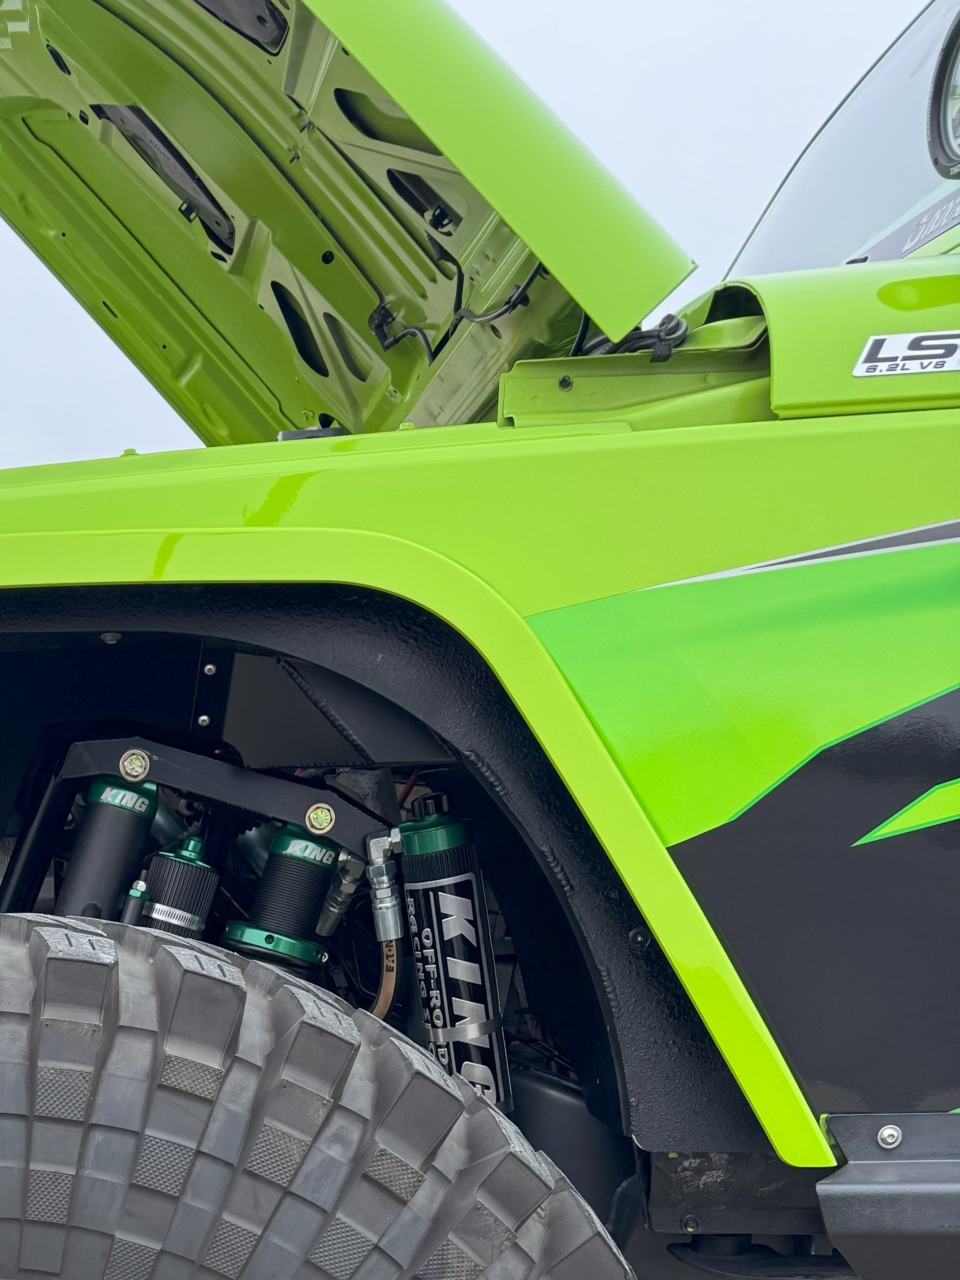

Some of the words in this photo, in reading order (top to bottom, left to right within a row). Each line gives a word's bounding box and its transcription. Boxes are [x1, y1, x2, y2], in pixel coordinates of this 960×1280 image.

[865, 362, 910, 373] 6.2L
[920, 360, 946, 370] V8
[100, 786, 150, 813] KING
[286, 839, 336, 866] KING
[421, 927, 449, 1066] OFF-ROD
[438, 891, 497, 1104] KING
